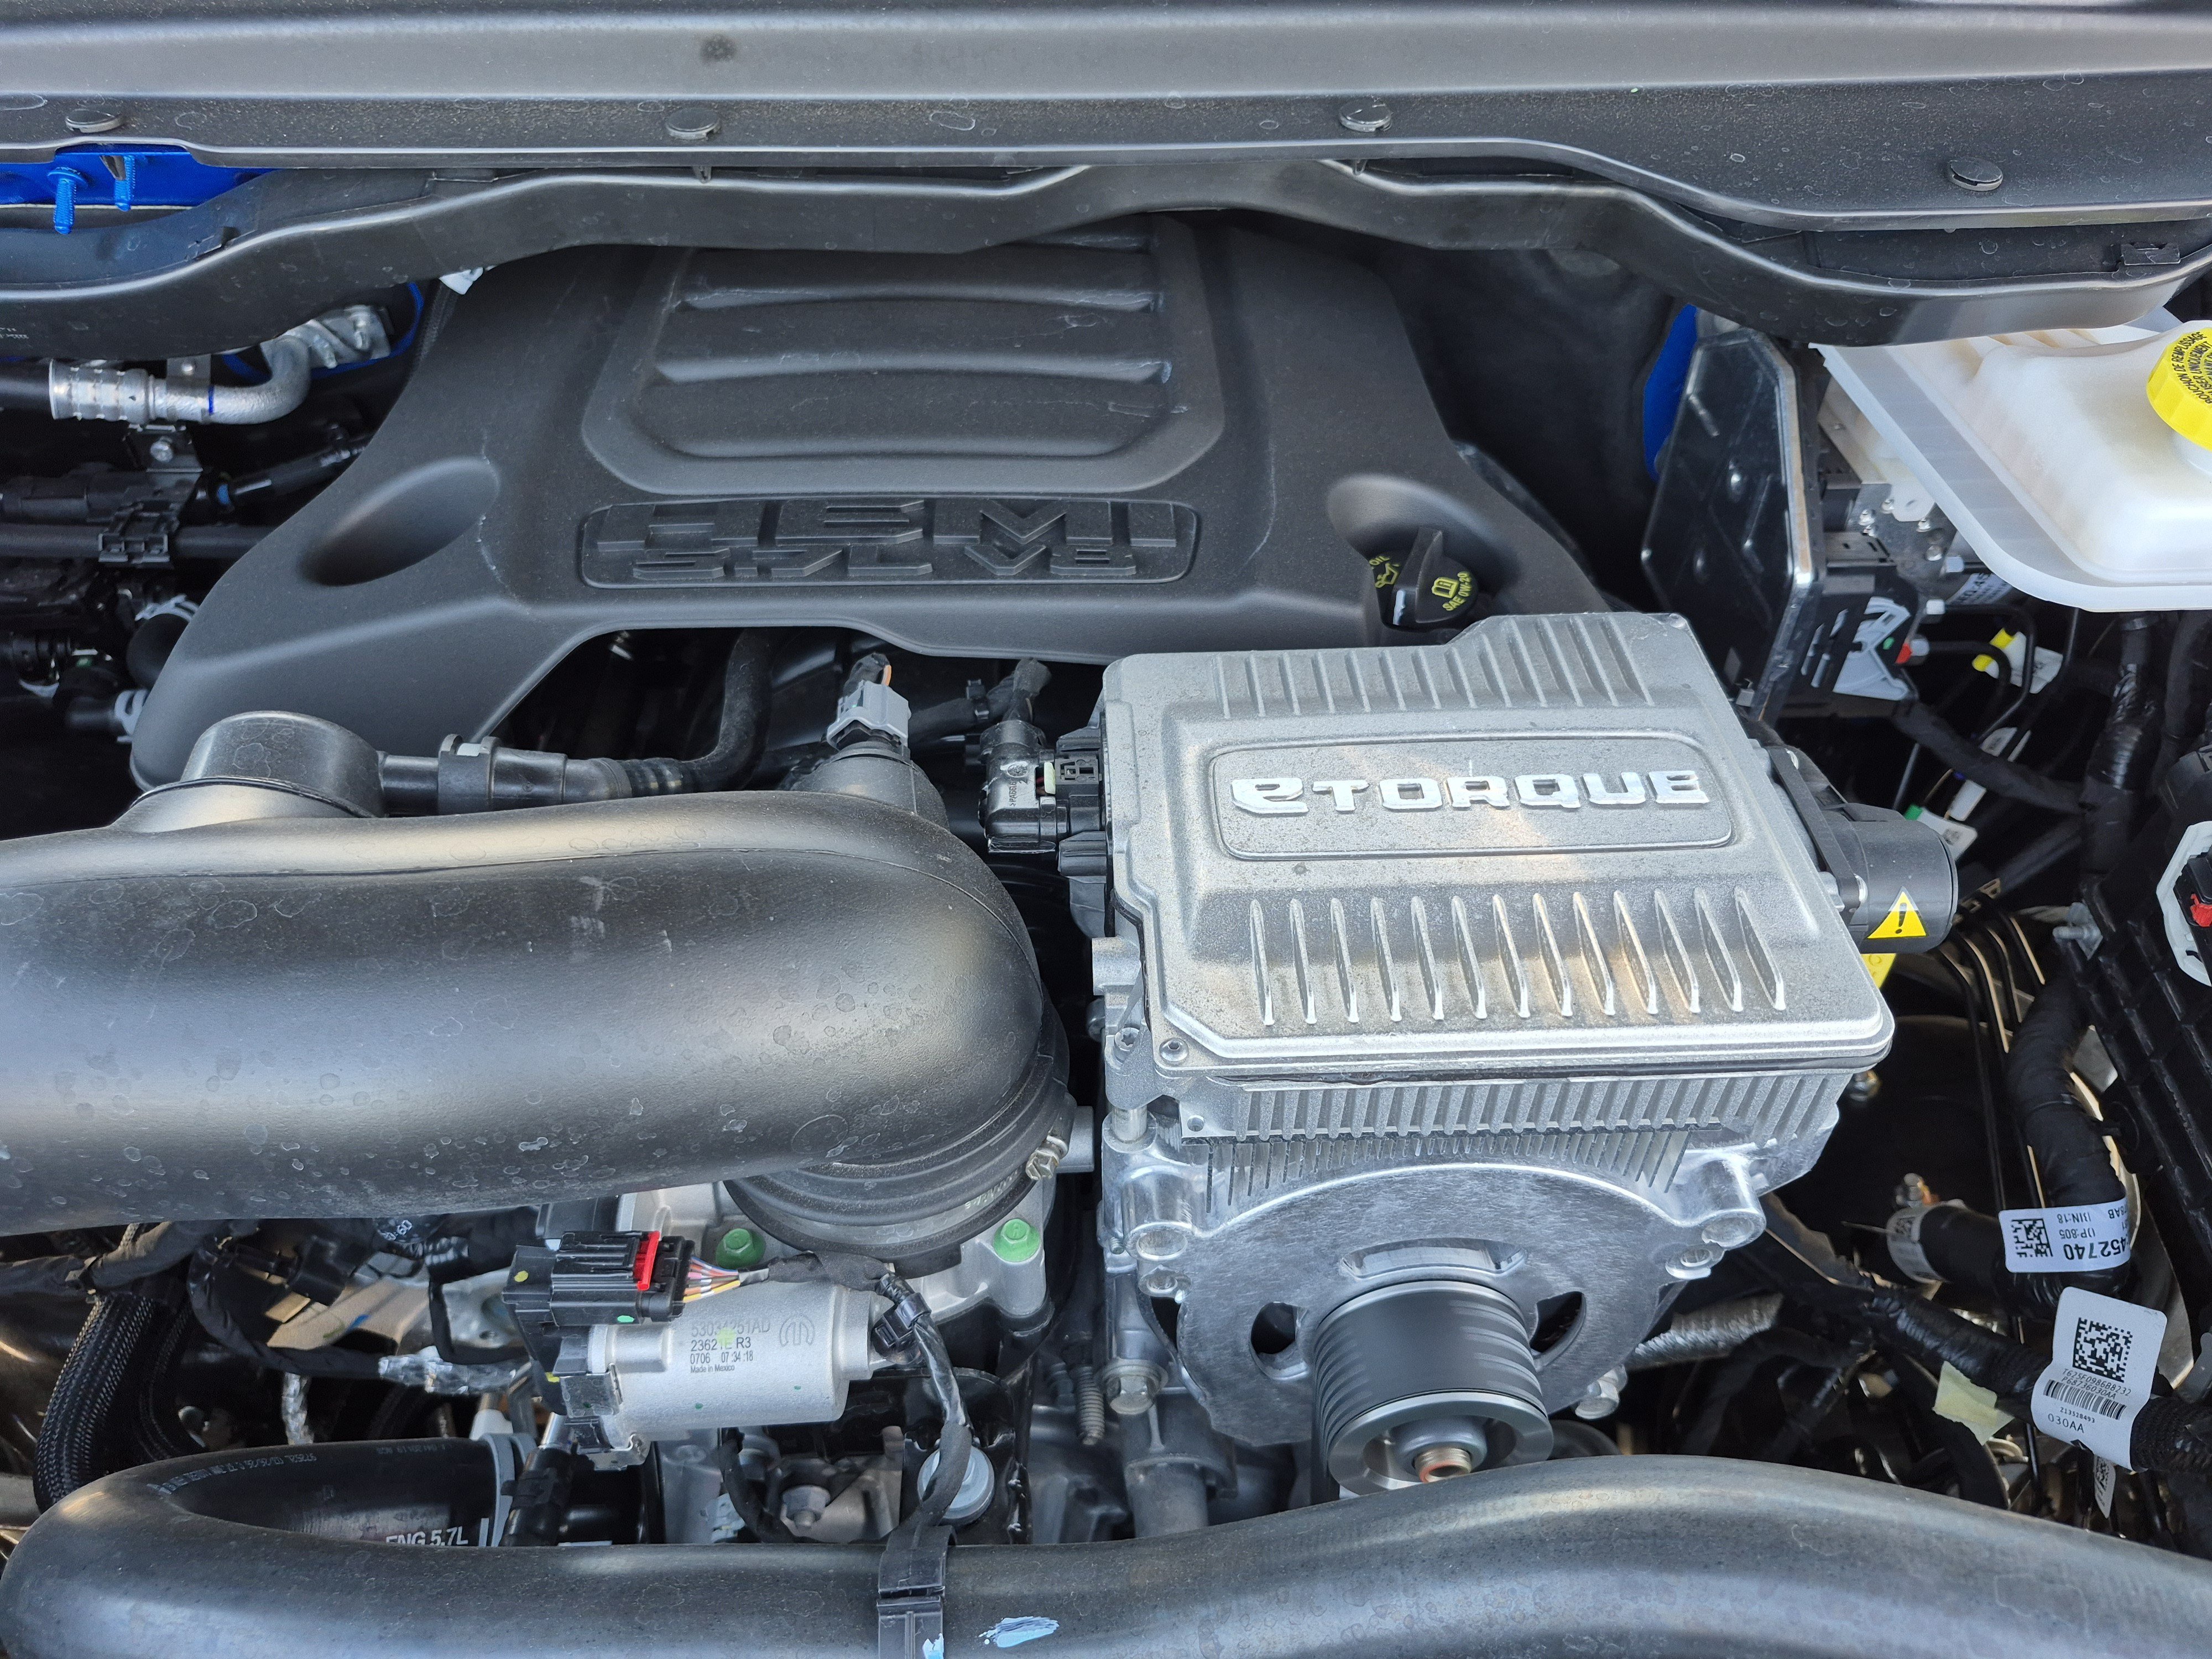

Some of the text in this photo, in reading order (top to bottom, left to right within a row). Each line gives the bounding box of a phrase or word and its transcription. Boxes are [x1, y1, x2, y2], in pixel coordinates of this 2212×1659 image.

[2171, 331, 2208, 363] REMPLISSAGE
[2172, 363, 2187, 372] DE
[597, 500, 1176, 551] HEMI
[633, 545, 1136, 580] 5.7L V8
[1369, 555, 1390, 566] OIL
[1442, 597, 1467, 612] SAE
[1231, 770, 1710, 815] eTORQUE
[736, 1336, 751, 1349] R3
[690, 1352, 711, 1365] 0706
[2061, 1376, 2116, 1400] P68736030AA
[2062, 1368, 2132, 1397] T625F0986B8232
[2047, 1413, 2084, 1433] 030AA
[430, 1526, 468, 1546] 5.7L
